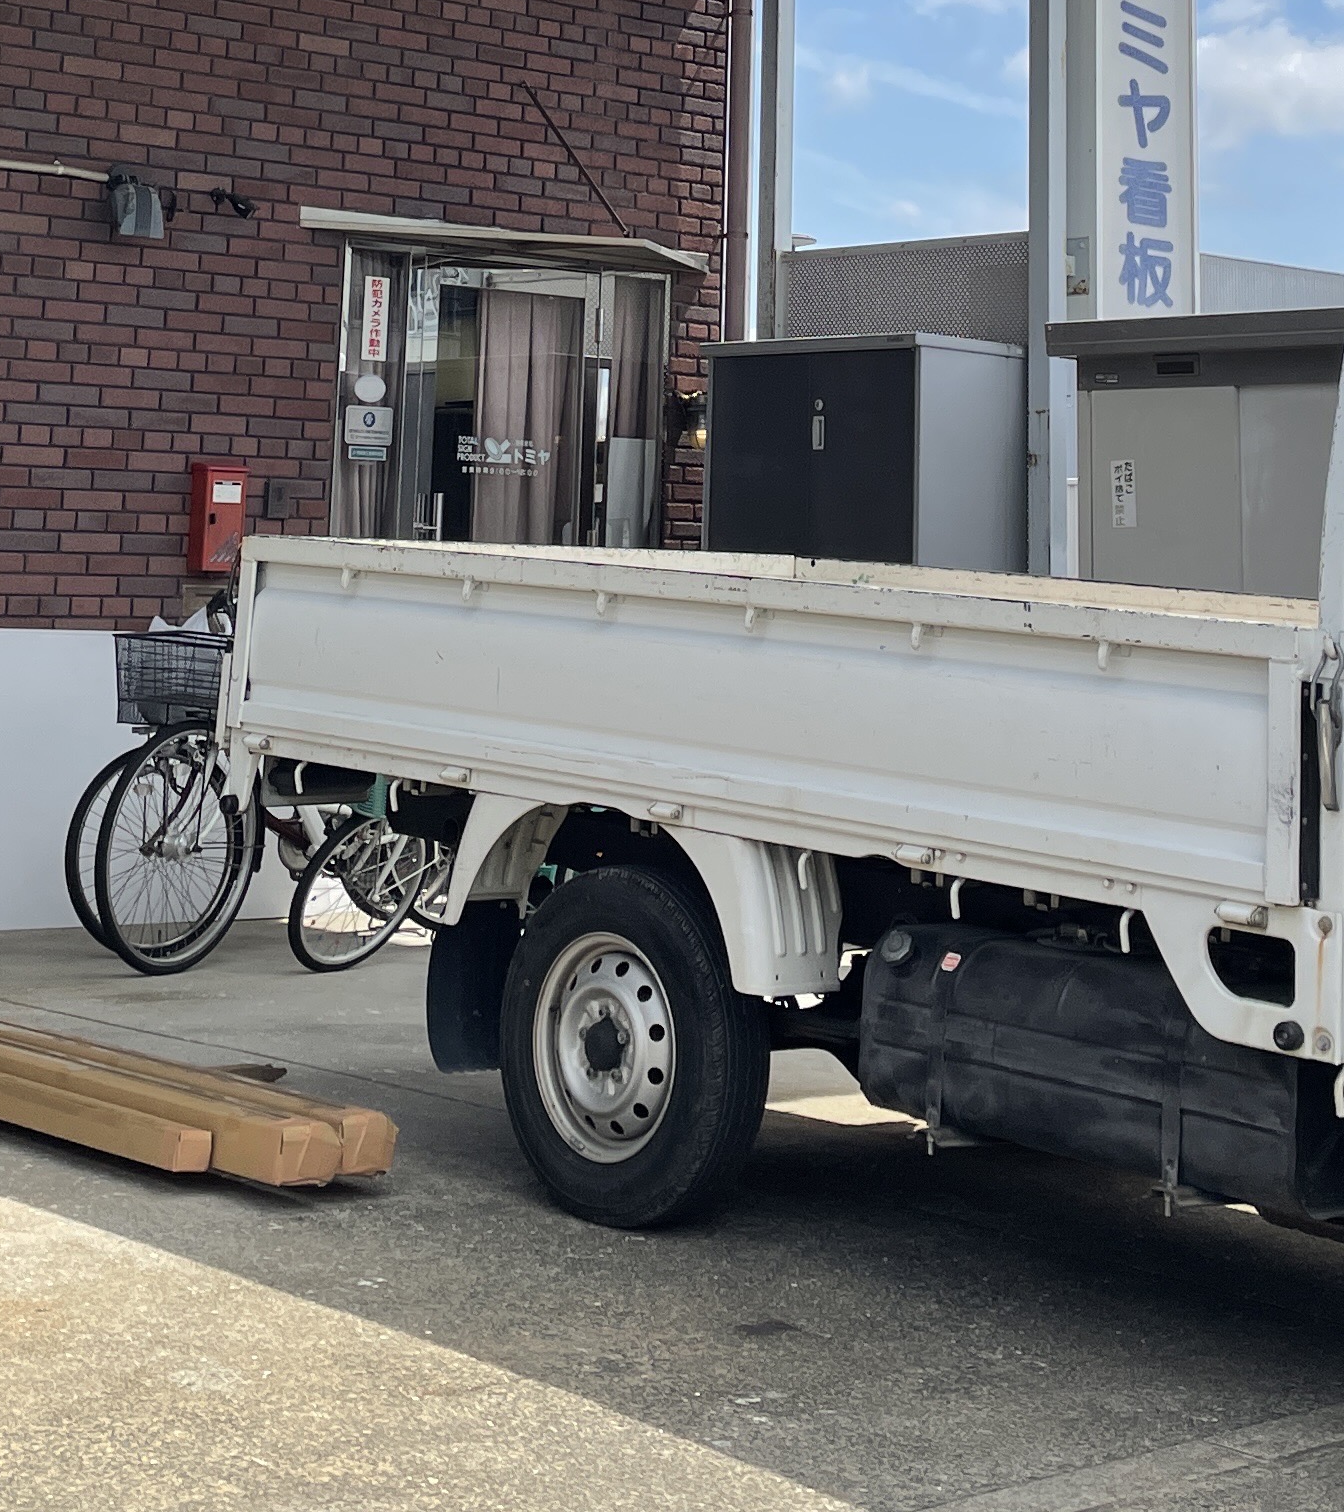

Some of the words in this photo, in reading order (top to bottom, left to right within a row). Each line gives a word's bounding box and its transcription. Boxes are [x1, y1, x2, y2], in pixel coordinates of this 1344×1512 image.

[368, 279, 383, 357] 防犯カメラ作動中
[458, 435, 479, 445] TOTAL
[457, 453, 485, 462] PRODUCT
[514, 448, 550, 465] トミヤ
[1124, 461, 1133, 494] たばこ
[1114, 464, 1125, 526] ポイ捨て禁止
